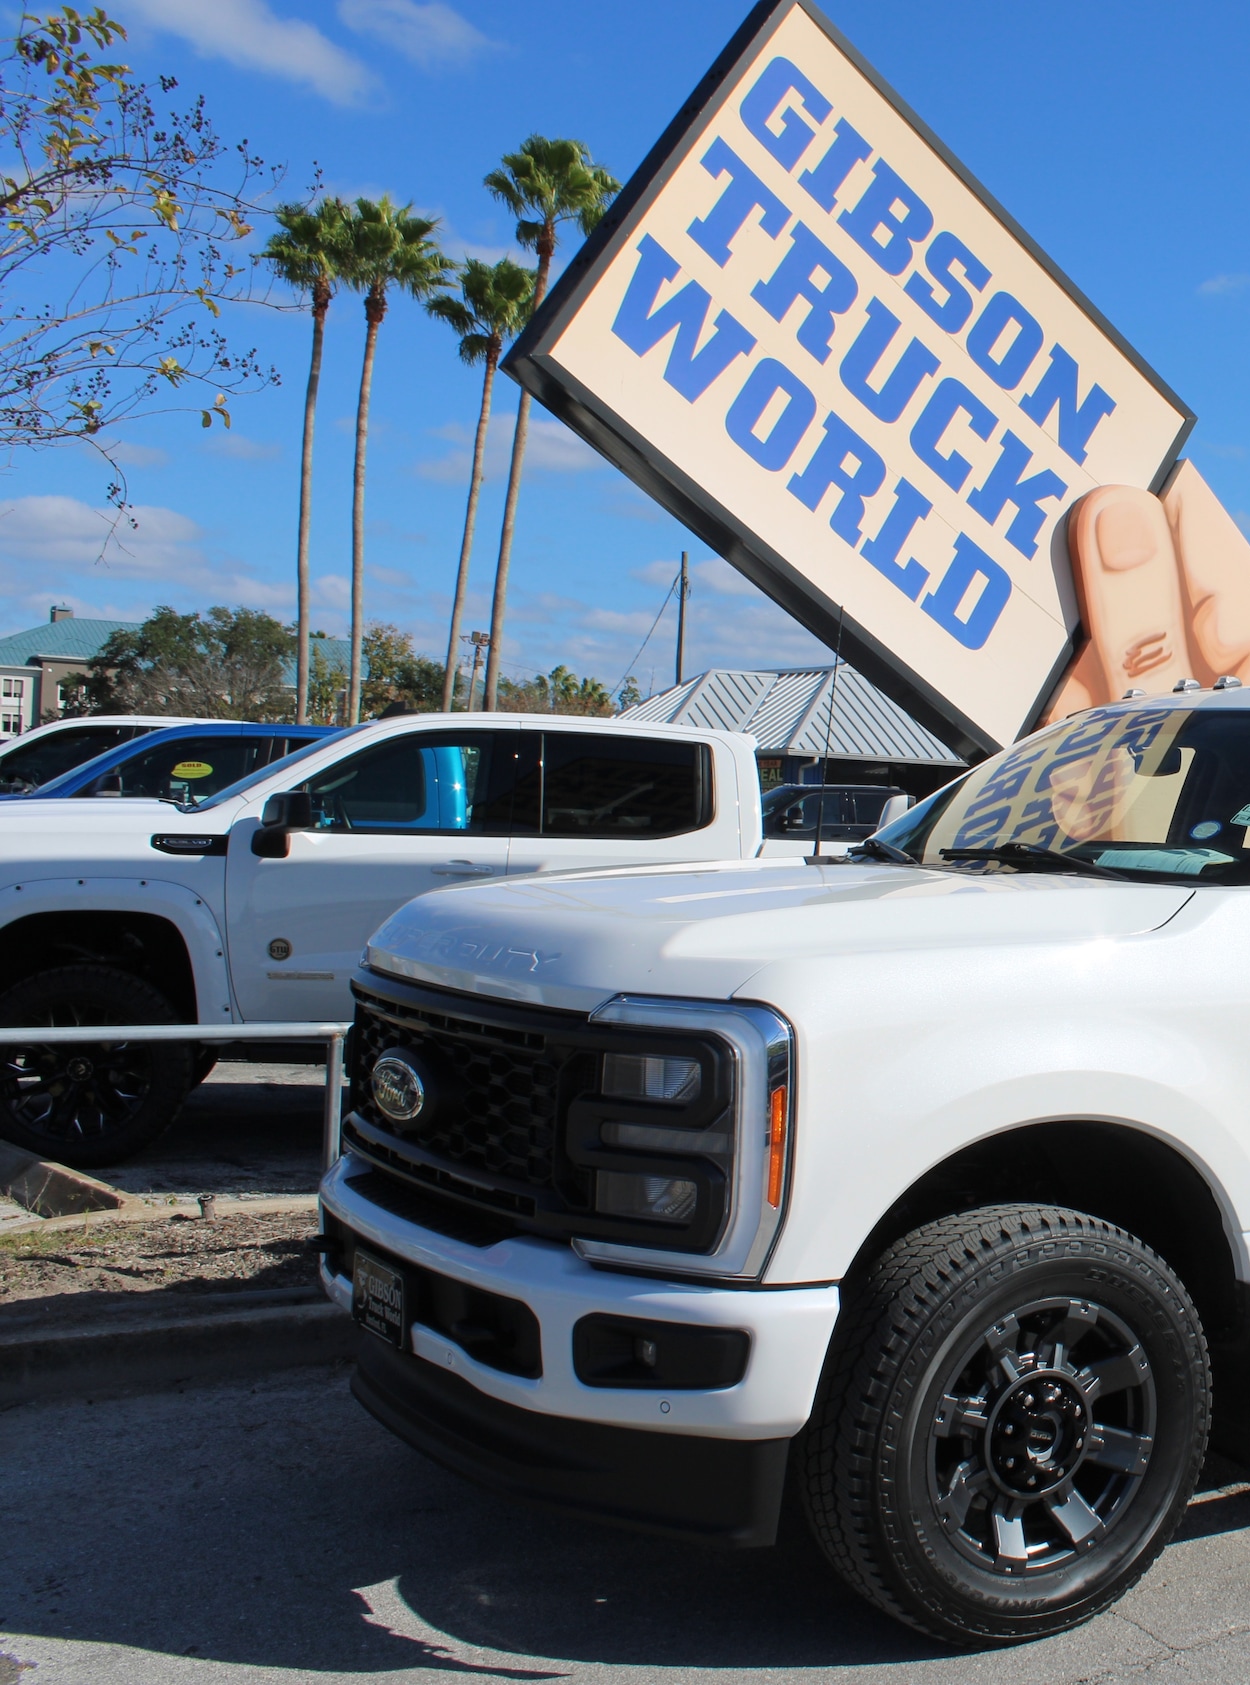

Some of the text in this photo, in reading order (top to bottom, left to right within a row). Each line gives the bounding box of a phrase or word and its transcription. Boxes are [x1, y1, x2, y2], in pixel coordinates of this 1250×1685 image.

[610, 232, 1013, 651] WORLD
[685, 136, 1069, 561] TRUCK
[739, 56, 1117, 466] GIBSON
[761, 768, 783, 781] EAL
[368, 1275, 402, 1310] GIBSON
